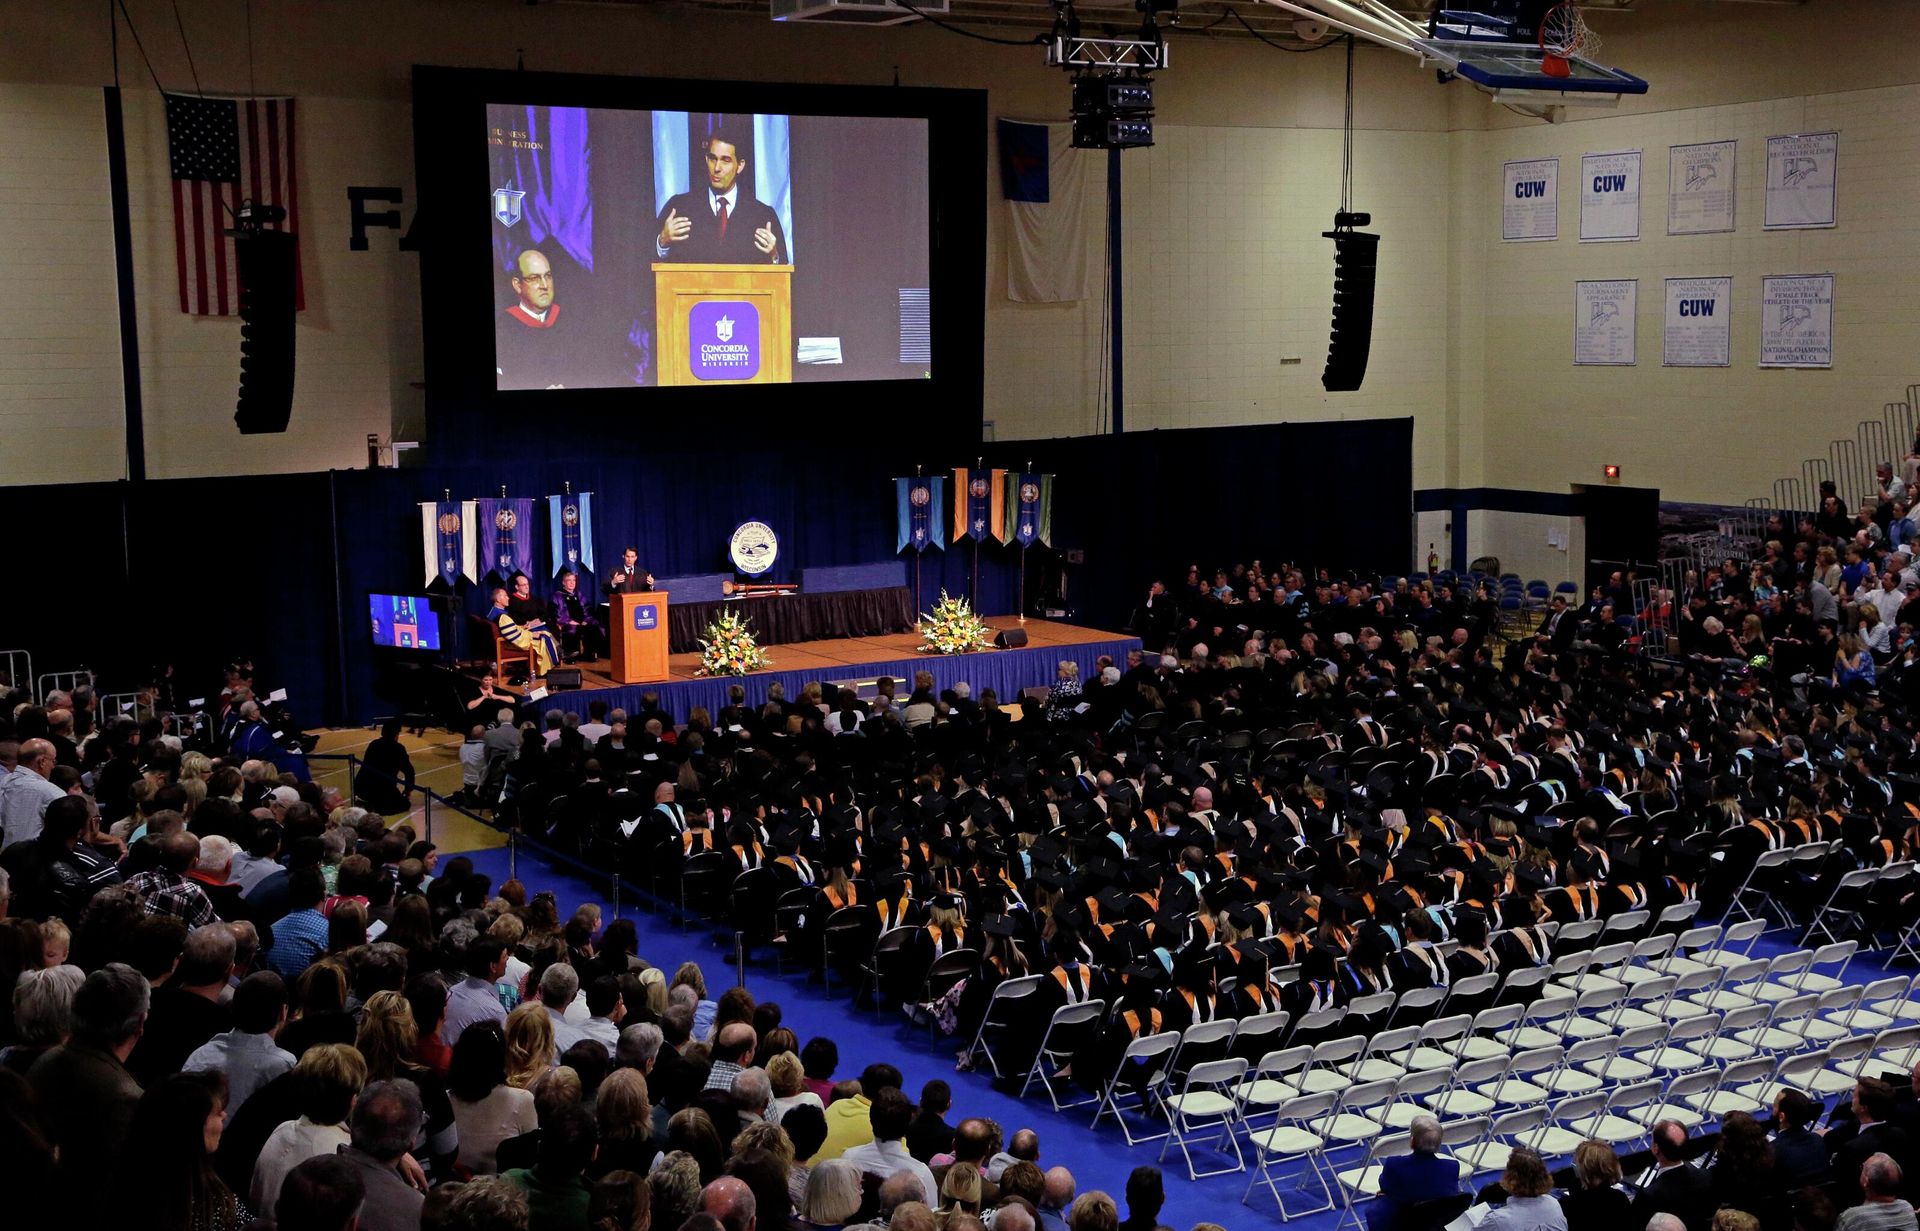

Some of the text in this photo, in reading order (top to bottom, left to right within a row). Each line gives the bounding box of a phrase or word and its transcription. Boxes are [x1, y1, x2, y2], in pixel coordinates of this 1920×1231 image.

[1515, 180, 1546, 198] CUW
[1593, 174, 1627, 193] CUW
[1679, 299, 1715, 317] CUW
[701, 344, 748, 353] CONCORDIA
[701, 352, 749, 361] UNIVERSITY
[733, 523, 754, 543] CONCORDIA
